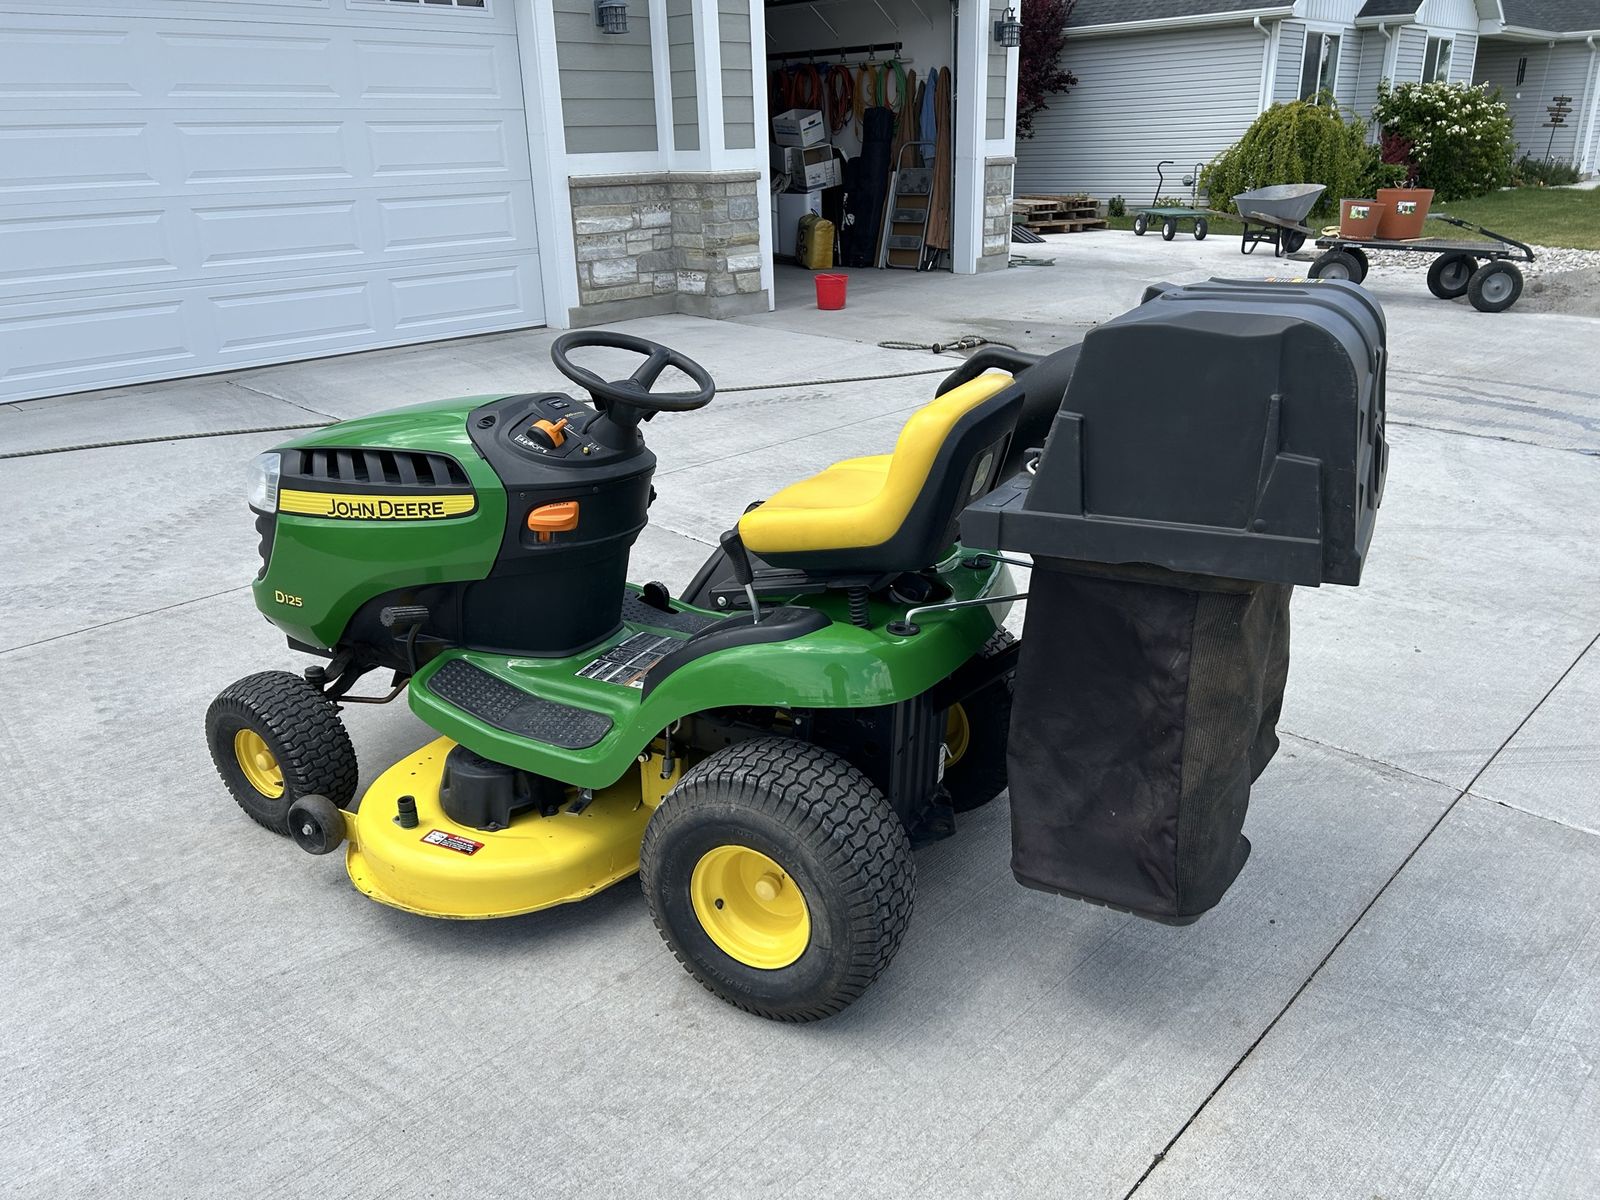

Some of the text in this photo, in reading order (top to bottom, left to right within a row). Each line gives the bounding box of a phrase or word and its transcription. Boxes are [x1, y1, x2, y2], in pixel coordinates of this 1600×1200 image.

[327, 498, 445, 517] JOHN DEERE
[275, 590, 303, 607] D125
